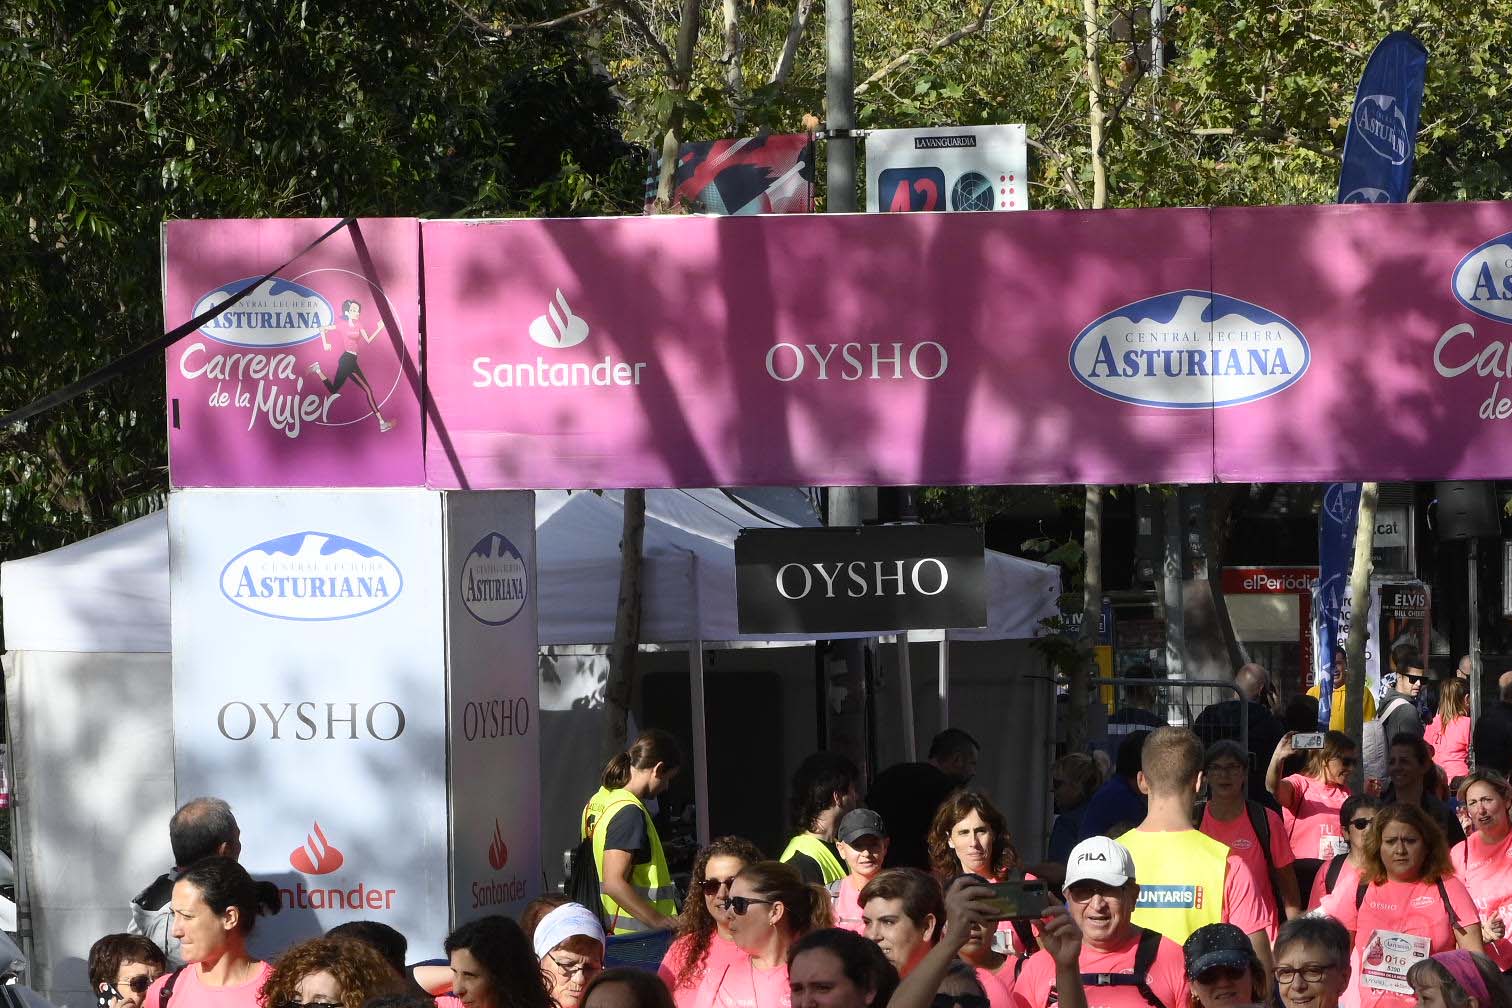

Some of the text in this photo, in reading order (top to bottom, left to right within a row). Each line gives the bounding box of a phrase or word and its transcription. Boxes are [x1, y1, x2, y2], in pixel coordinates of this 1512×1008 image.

[1125, 330, 1282, 343] CENTRAL LECHERA
[180, 343, 296, 380] Carrera
[472, 356, 646, 388] Santander
[765, 340, 949, 382] OYSHO
[1088, 335, 1291, 378] ASTURIANA
[208, 376, 341, 438] de la Mujer
[234, 564, 390, 599] ASTURIANA
[466, 567, 524, 602] ASTURIANA
[775, 557, 949, 601] OYSHO
[1395, 594, 1425, 606] ELVIS
[216, 700, 406, 742] OYSHO
[463, 697, 530, 742] OYSHO
[1077, 852, 1107, 864] FILA
[276, 883, 396, 910] ntander
[471, 879, 527, 909] Santander
[1135, 890, 1193, 902] UNTARIS
[1385, 955, 1406, 965] 016
